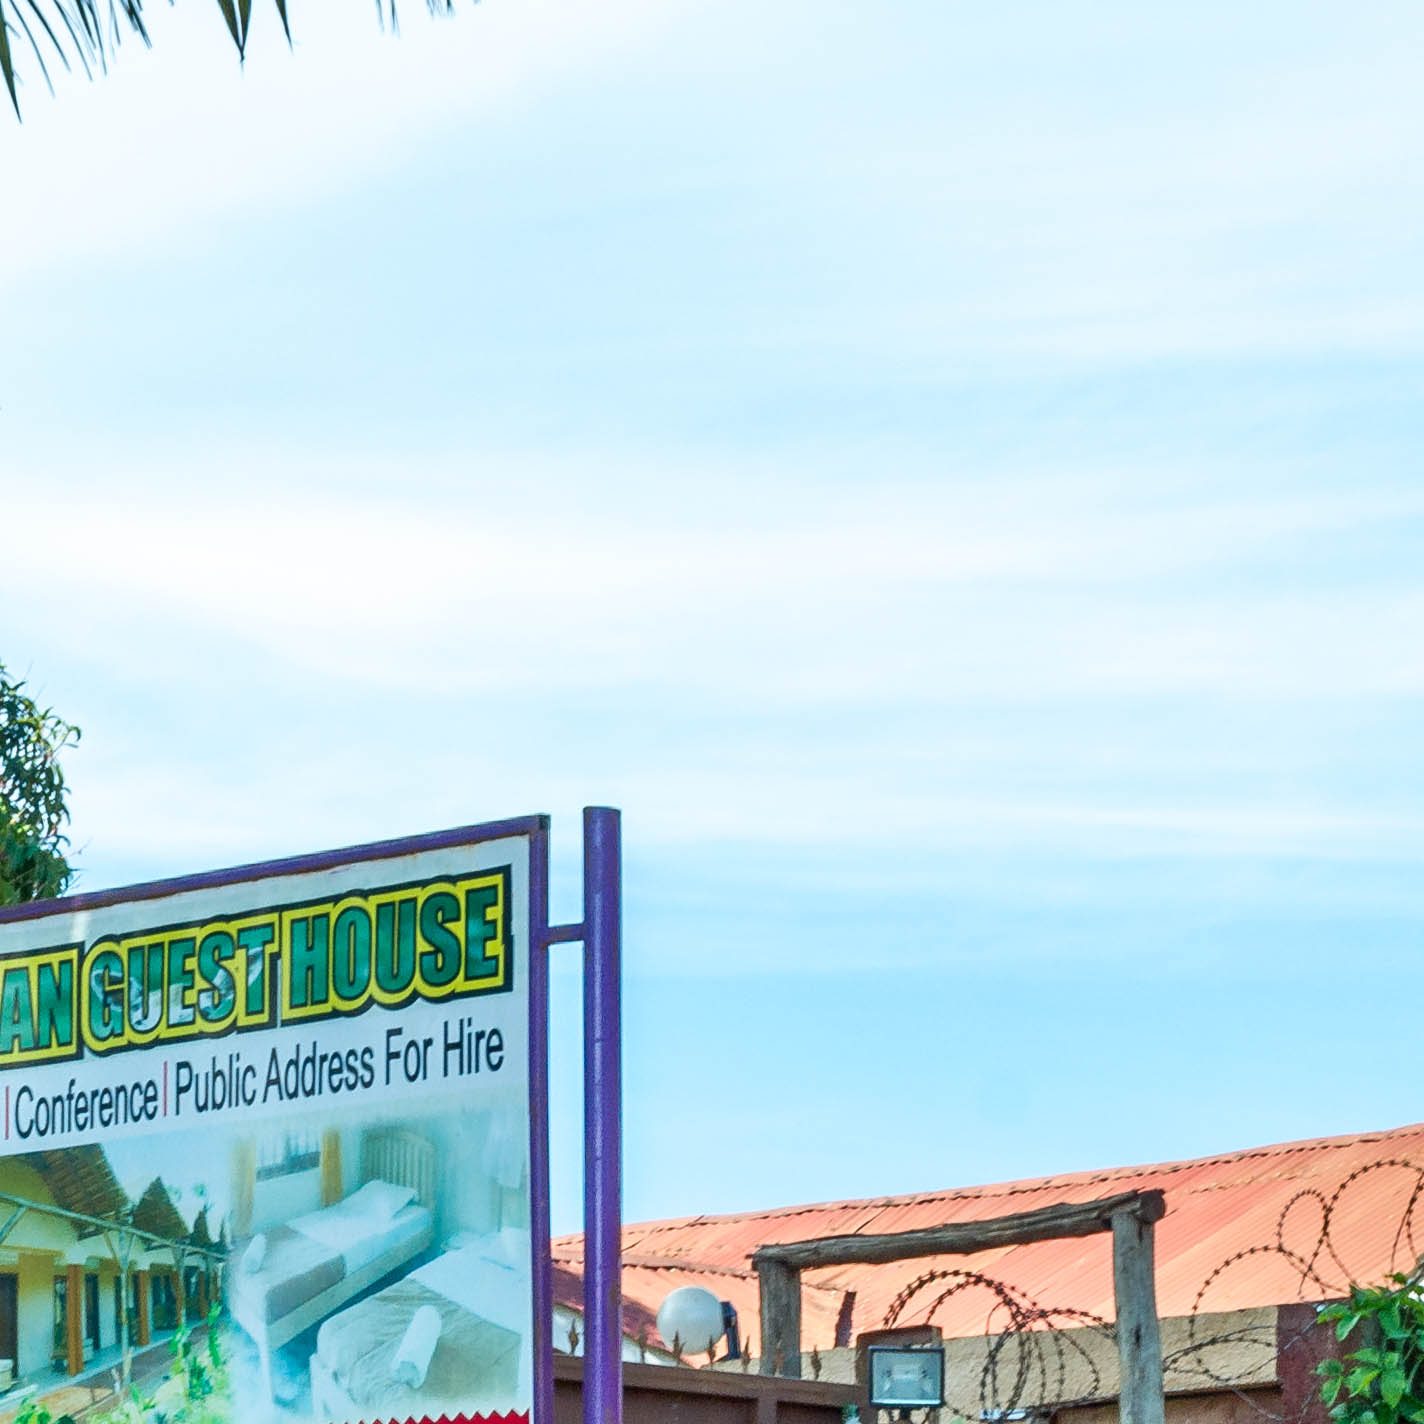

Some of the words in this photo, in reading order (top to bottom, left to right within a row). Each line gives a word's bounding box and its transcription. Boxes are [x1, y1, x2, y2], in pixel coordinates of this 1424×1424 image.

[86, 920, 277, 1042] GUEST
[287, 883, 502, 1009] HOUSE
[14, 1077, 158, 1138] Conference
[175, 1053, 257, 1117] Public
[262, 1040, 376, 1104] Address
[385, 1026, 434, 1086] For
[443, 1017, 505, 1078] Hire
